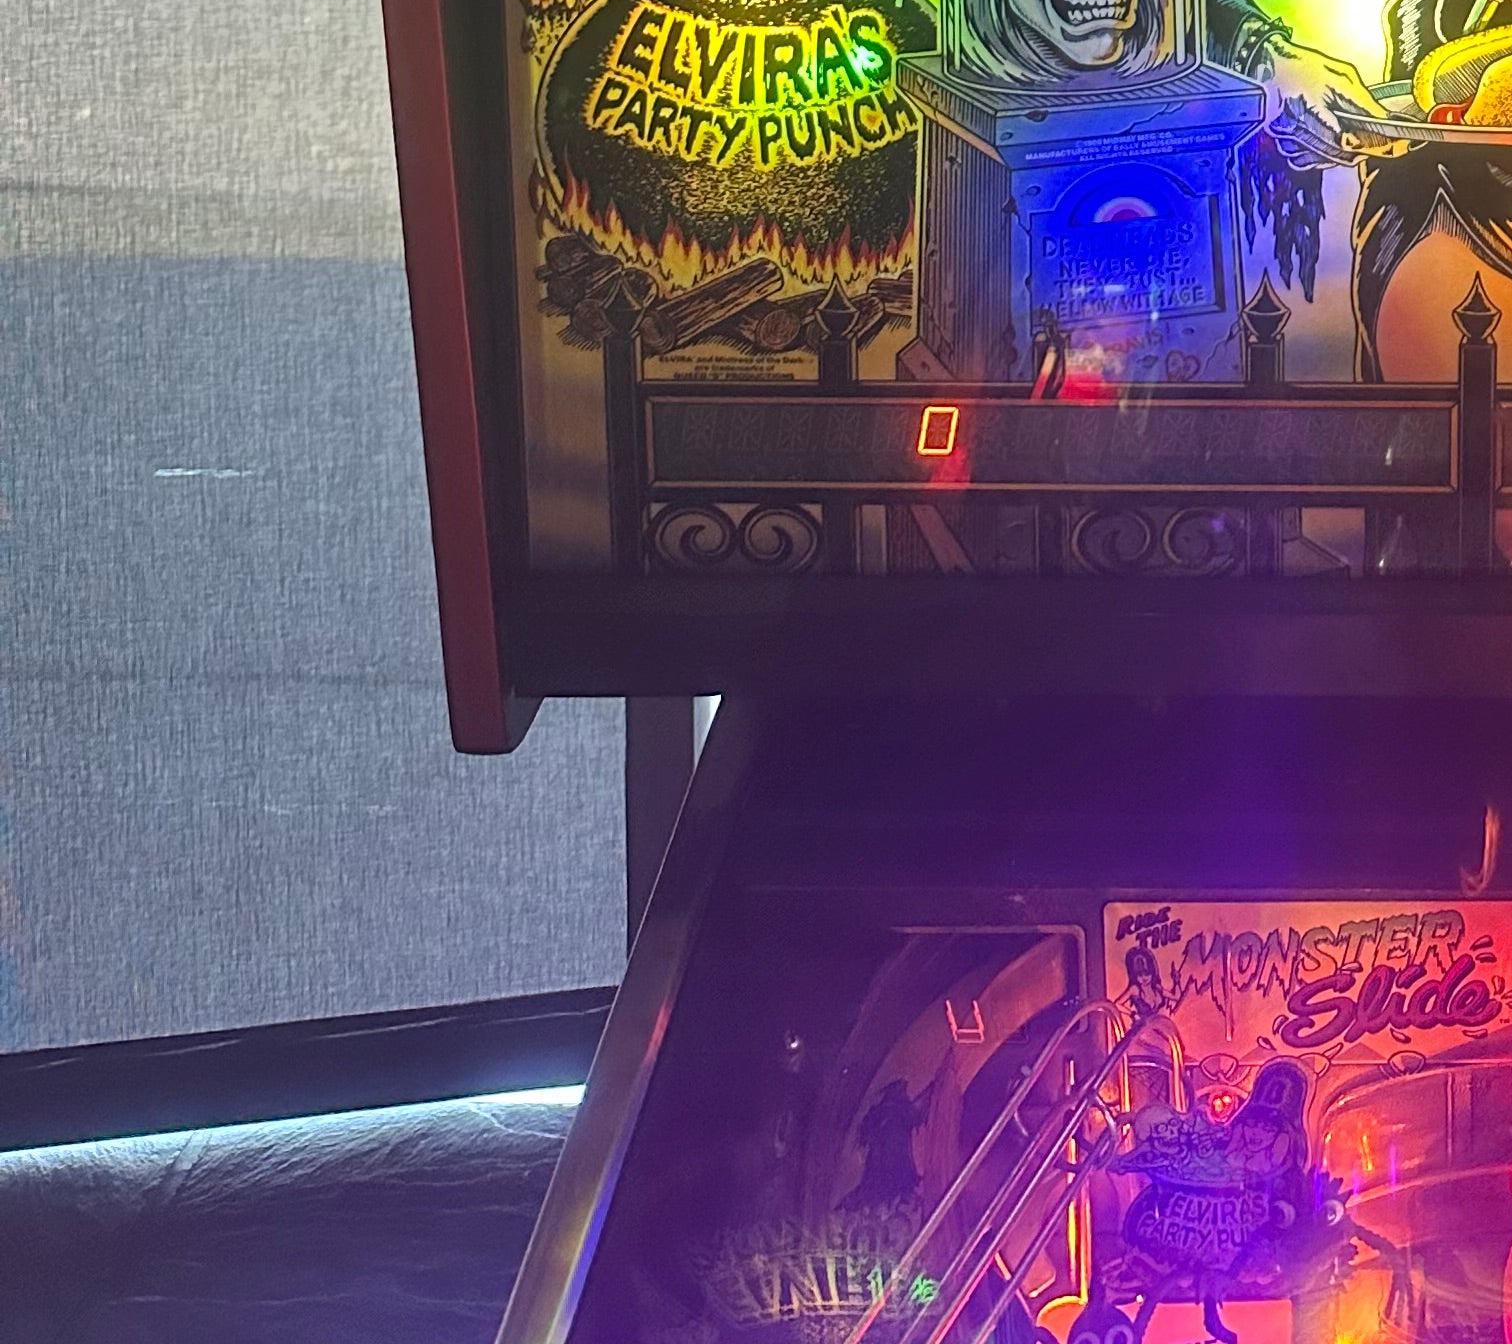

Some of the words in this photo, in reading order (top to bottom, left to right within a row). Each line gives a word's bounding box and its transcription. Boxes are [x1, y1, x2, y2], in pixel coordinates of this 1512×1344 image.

[617, 2, 894, 105] ELVIRA'S
[591, 78, 749, 164] PARTY
[757, 90, 918, 165] PUNCH
[1059, 256, 1137, 278] NEVER
[1166, 285, 1205, 306] AGE
[1115, 906, 1171, 940] RIDE
[1135, 919, 1183, 949] THE
[1170, 909, 1466, 1016] MONSTER
[1281, 954, 1502, 1048] Slide
[1138, 1213, 1212, 1250] PARTY
